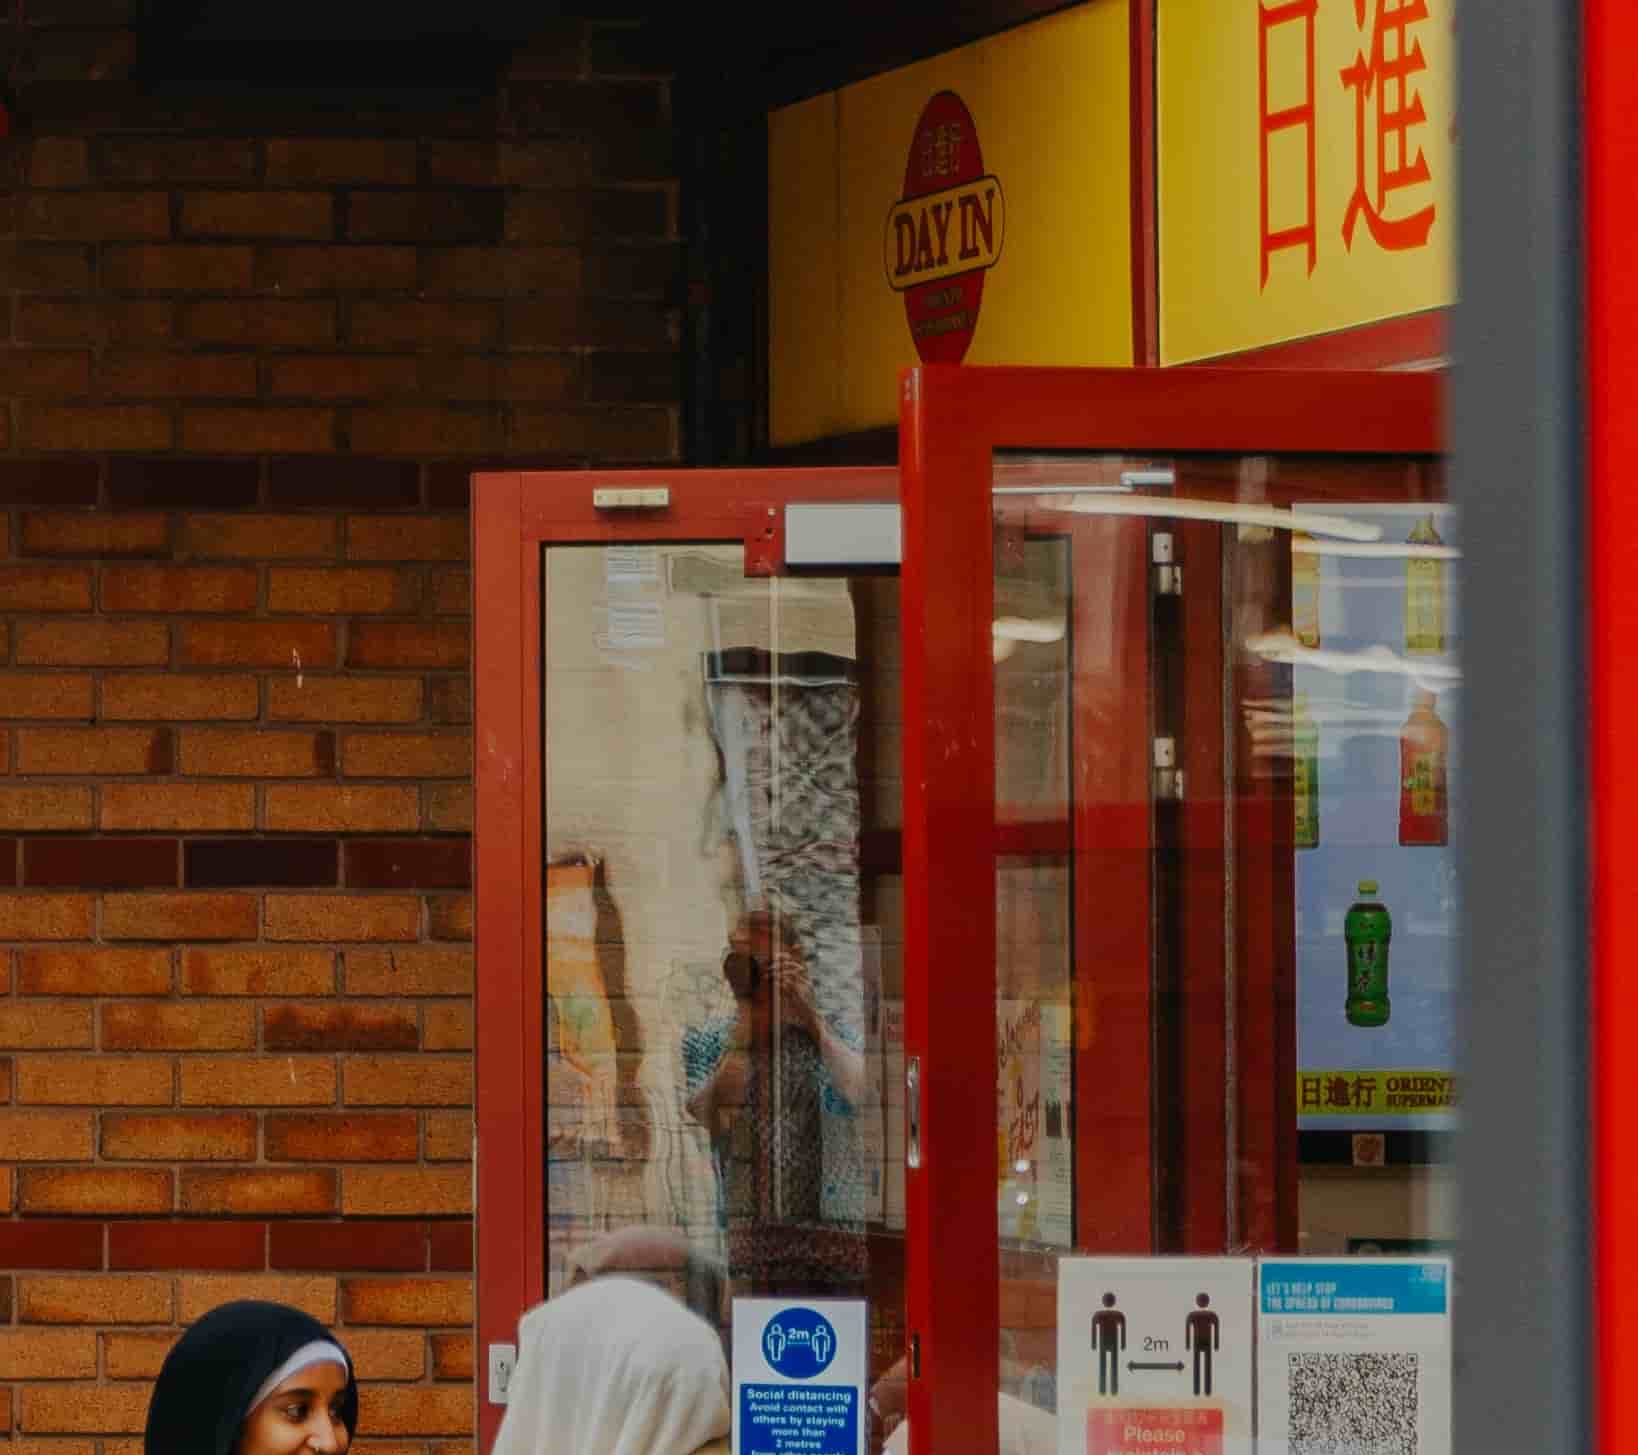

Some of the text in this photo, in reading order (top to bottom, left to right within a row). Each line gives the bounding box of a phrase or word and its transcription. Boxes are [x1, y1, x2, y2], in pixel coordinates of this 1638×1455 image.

[893, 188, 996, 277] DAY IN
[787, 1327, 809, 1340] 2m
[1143, 1336, 1169, 1352] 2m
[746, 1388, 852, 1404] Social distancing
[752, 1415, 786, 1425] others
[789, 1415, 802, 1427] by
[771, 1427, 826, 1437] more than
[1123, 1426, 1186, 1443] Please
